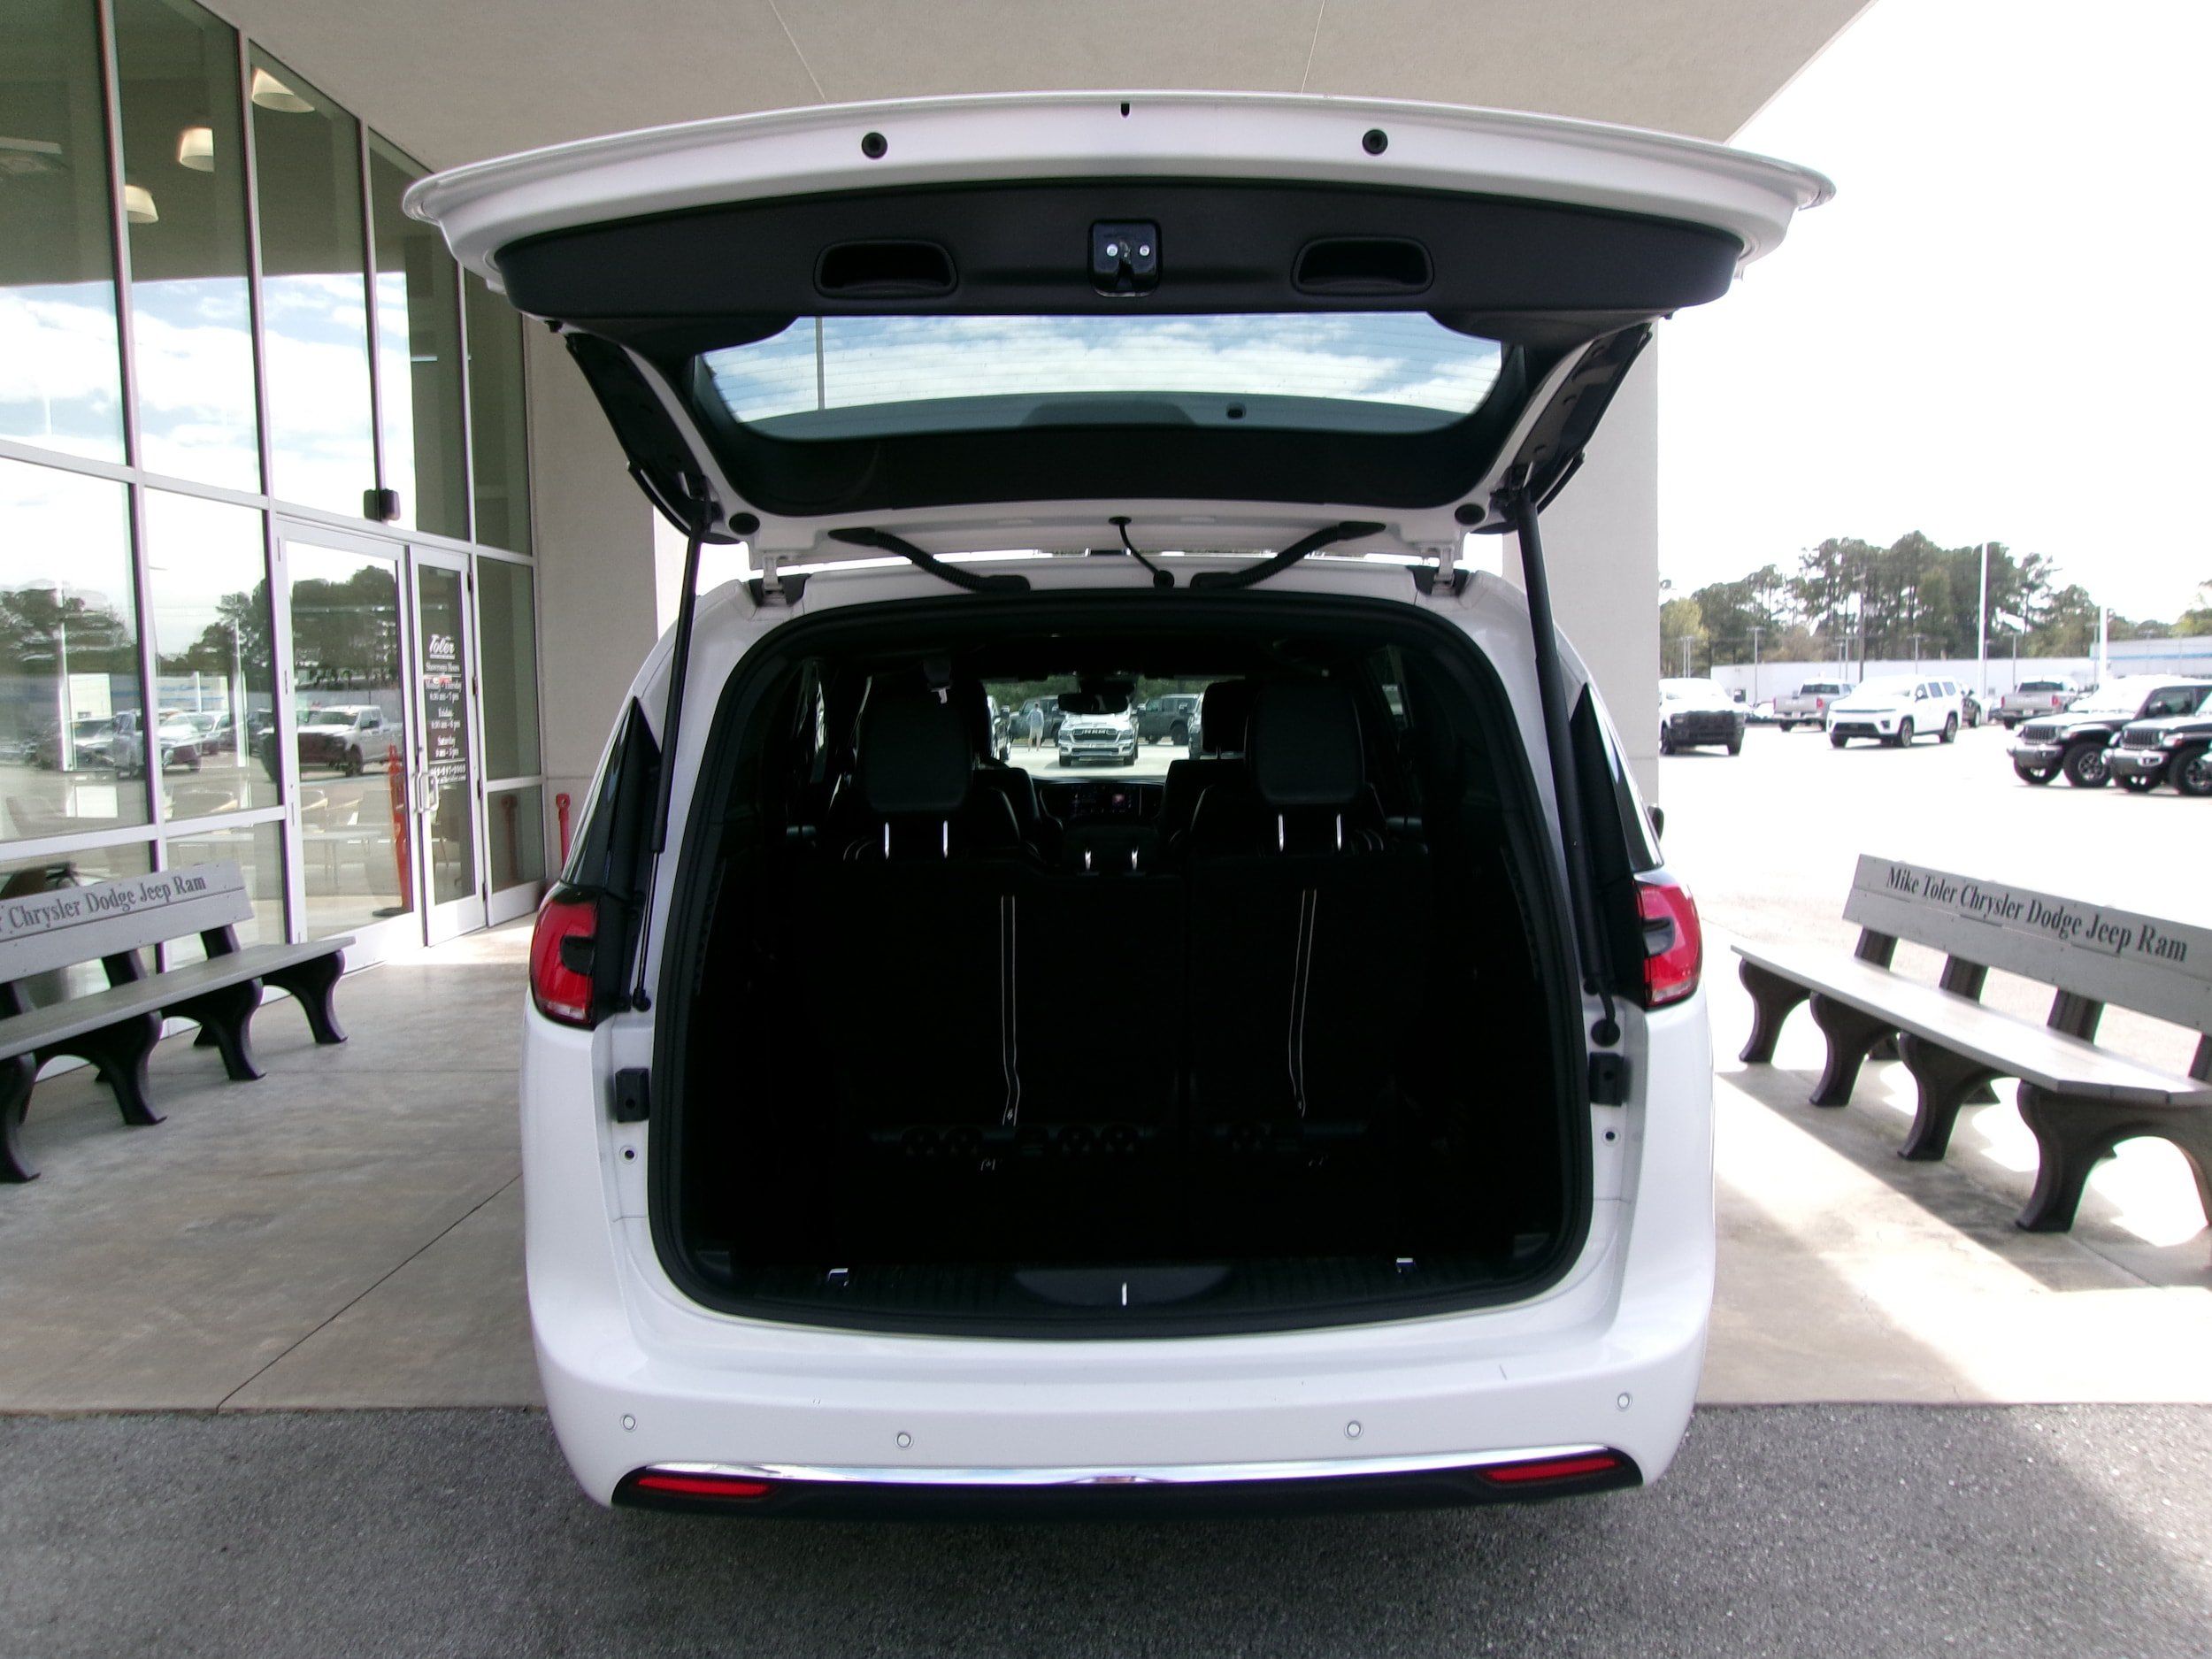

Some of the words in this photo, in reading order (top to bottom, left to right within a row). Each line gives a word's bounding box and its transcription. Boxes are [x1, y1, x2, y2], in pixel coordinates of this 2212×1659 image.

[429, 634, 455, 654] Toler
[9, 898, 81, 928] Chrysler
[85, 887, 135, 913] Dodge
[139, 882, 173, 903] Jeep
[174, 874, 207, 895] Ram
[1886, 866, 1919, 895] Mike
[1922, 873, 1958, 904] Toler
[1960, 884, 2024, 922] Chrysler
[2026, 899, 2083, 940] Dodge
[2085, 914, 2131, 956] Jeep
[2137, 923, 2188, 963] Ram
